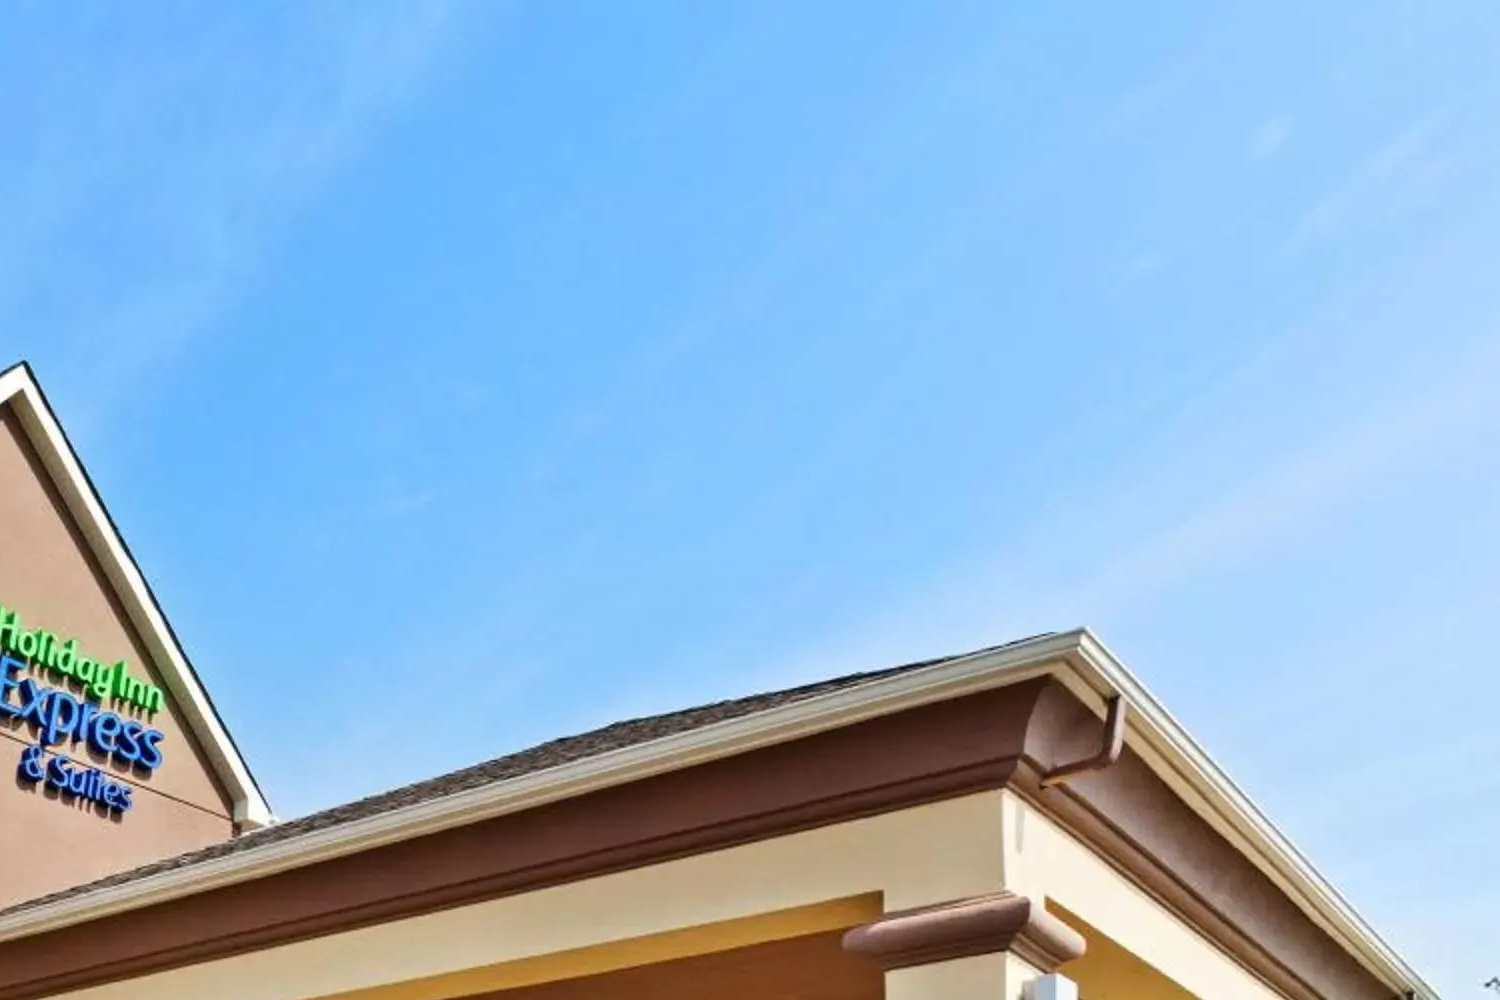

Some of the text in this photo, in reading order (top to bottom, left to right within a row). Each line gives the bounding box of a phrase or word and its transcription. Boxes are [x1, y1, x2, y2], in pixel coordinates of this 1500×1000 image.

[116, 660, 164, 711] Inn
[21, 746, 133, 812] & Suites
